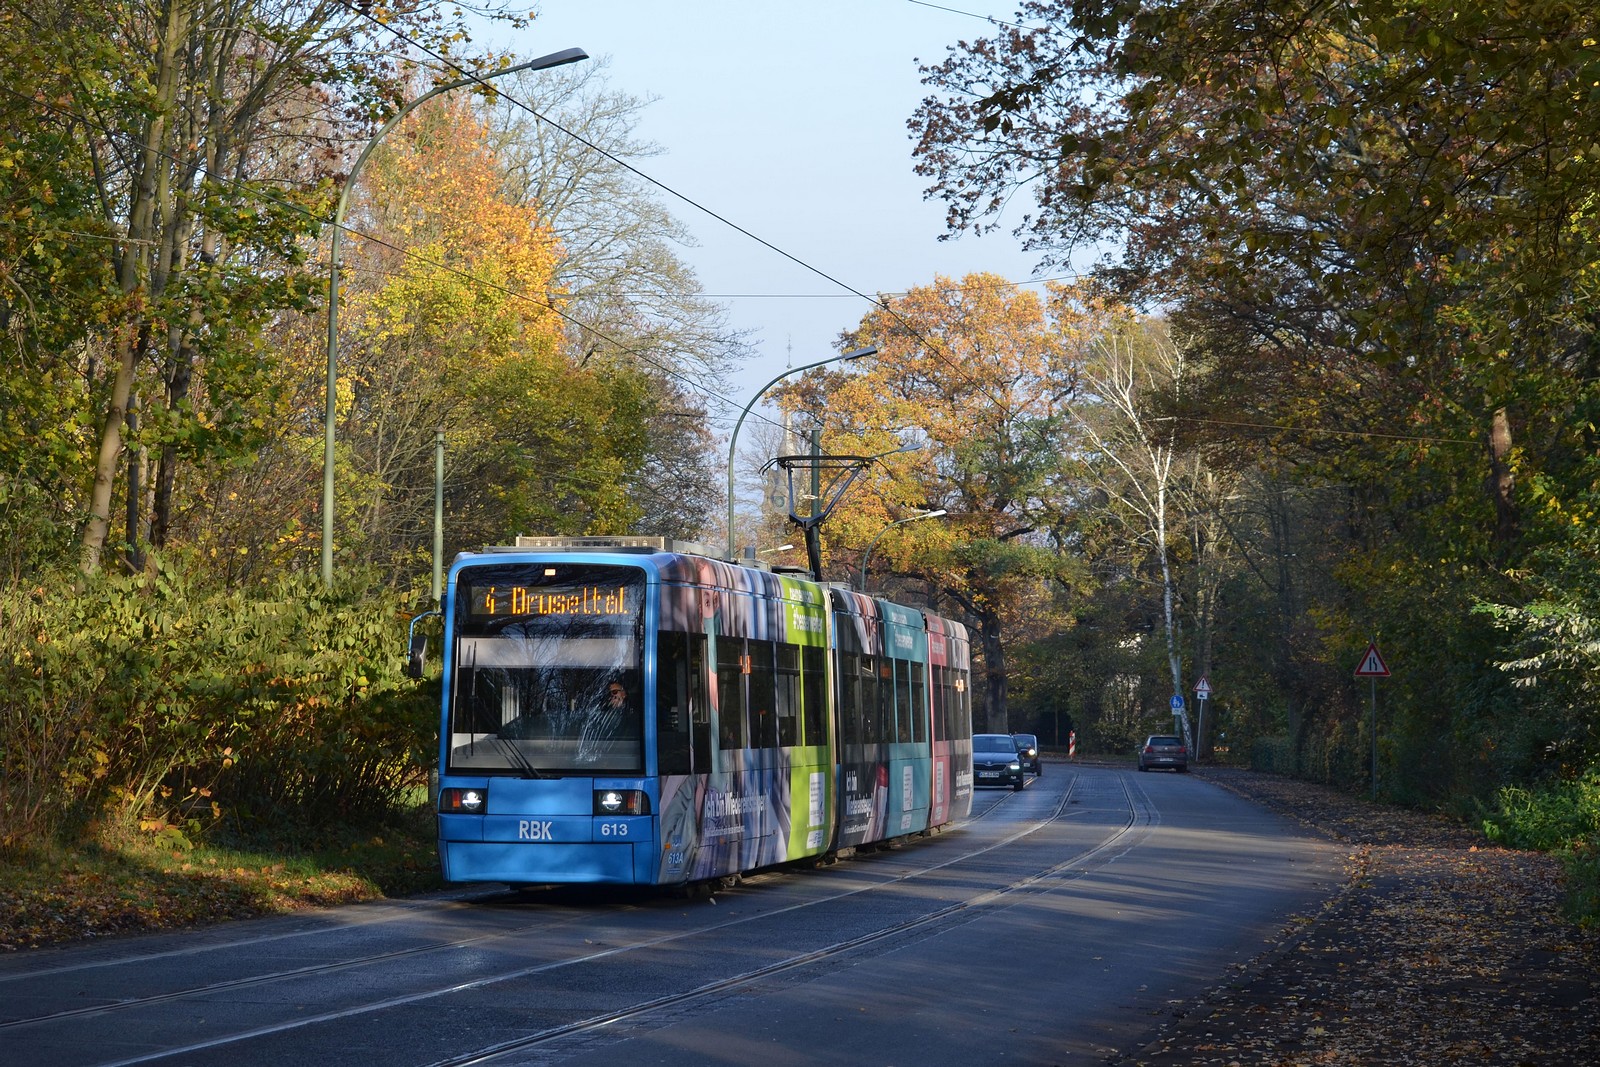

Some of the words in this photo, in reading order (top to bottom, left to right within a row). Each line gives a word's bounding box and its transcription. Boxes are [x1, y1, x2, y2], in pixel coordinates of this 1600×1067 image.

[485, 586, 495, 614] 4
[512, 586, 628, 614] Druseltal
[704, 793, 715, 818] Ich
[716, 792, 724, 817] bin
[519, 820, 553, 840] RBK
[601, 823, 628, 836] 613
[668, 852, 683, 864] 613A
